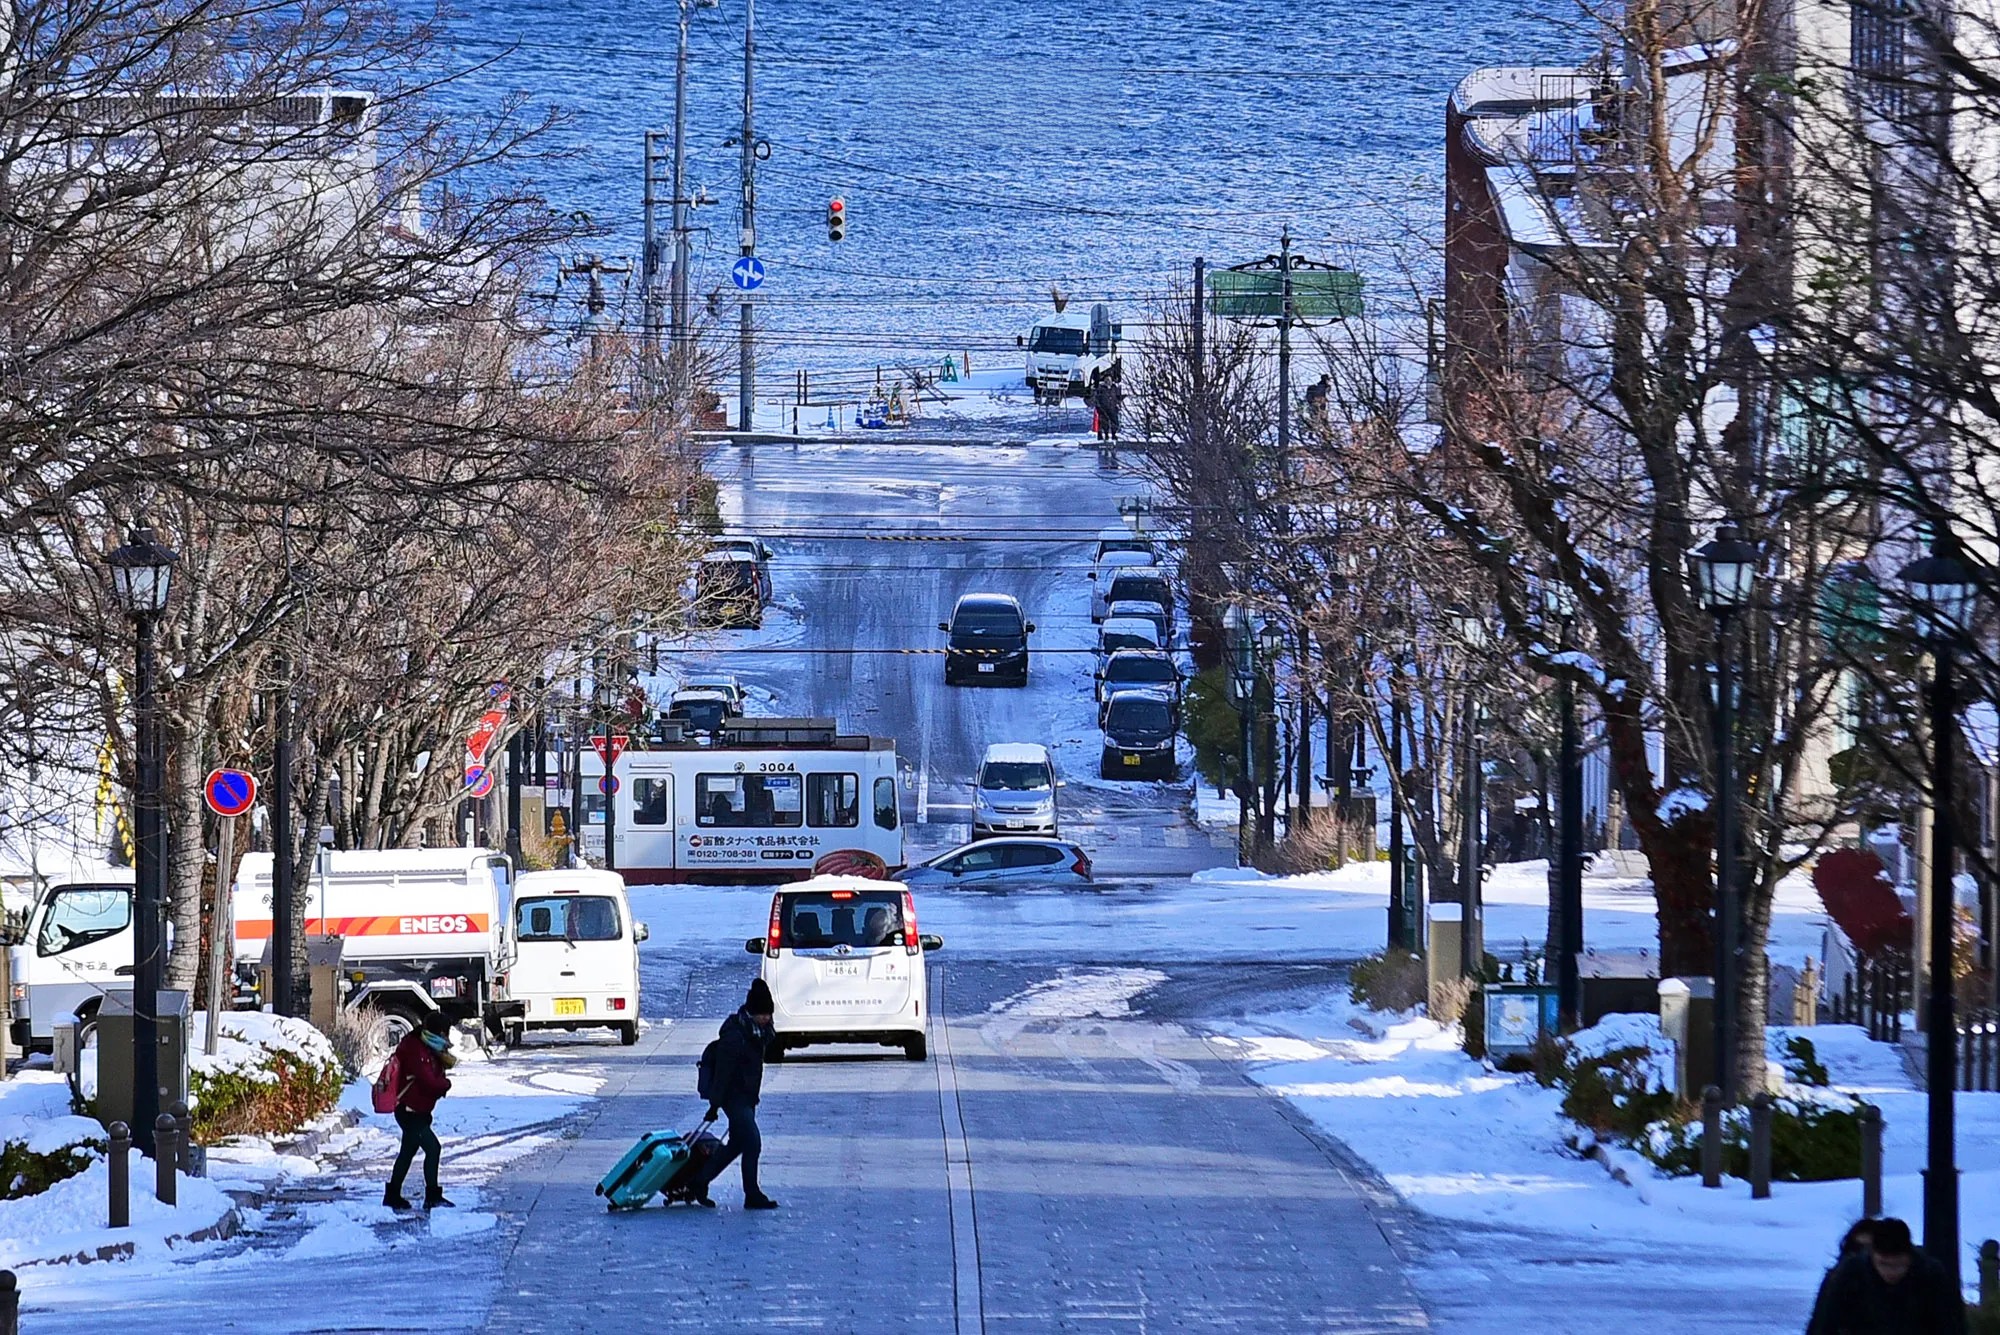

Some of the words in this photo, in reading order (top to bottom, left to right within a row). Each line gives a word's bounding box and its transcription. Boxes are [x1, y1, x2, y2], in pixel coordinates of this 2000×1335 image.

[598, 742, 621, 751] 止れ
[759, 762, 796, 772] 3004
[702, 835, 821, 847] 函館タナベ食品株式会社
[696, 850, 757, 858] 0120-708-381
[399, 915, 468, 933] ENEOS
